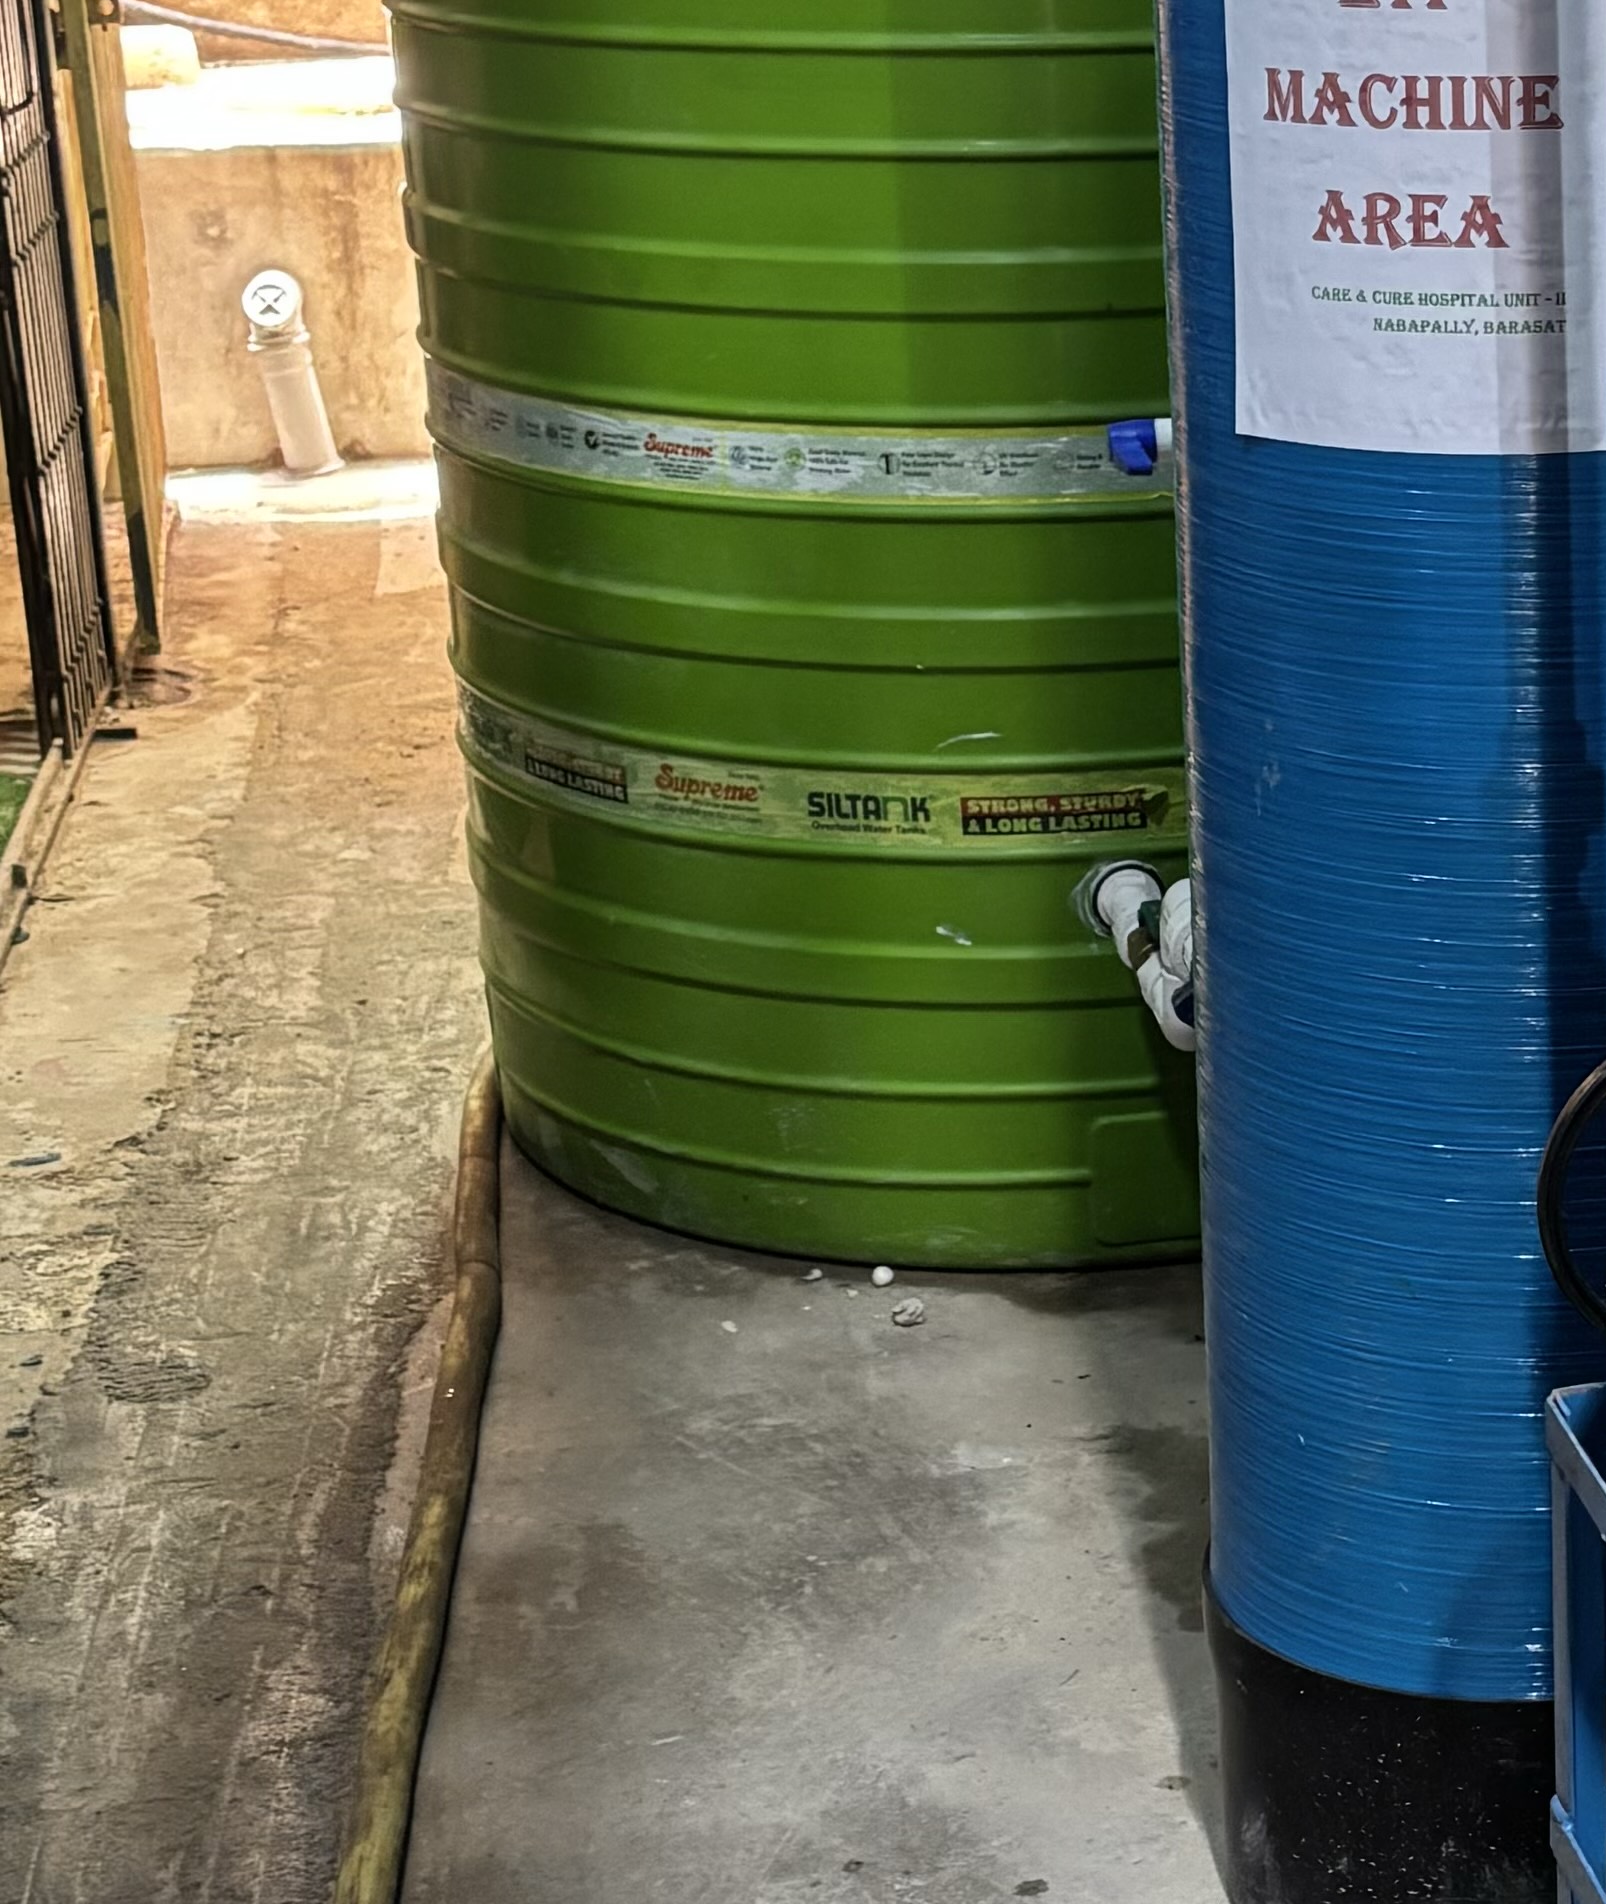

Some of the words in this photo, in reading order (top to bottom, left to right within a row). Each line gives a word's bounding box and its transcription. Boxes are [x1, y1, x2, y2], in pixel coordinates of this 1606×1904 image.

[1263, 67, 1565, 131] MACHINE
[1312, 190, 1510, 251] AREA
[1311, 286, 1352, 302] CARE
[1356, 290, 1367, 303] &
[1372, 290, 1415, 306] CURE
[1418, 293, 1500, 307] HOSPITAL
[1504, 292, 1542, 307] UNIT
[1373, 317, 1479, 336] NABAPALLY,
[1483, 319, 1567, 334] BARASAT
[644, 432, 714, 459] Supreme
[655, 763, 760, 802] Supreme
[967, 797, 1056, 814] STRONG,
[985, 817, 1042, 833] LONG
[1050, 812, 1141, 832] LASTING
